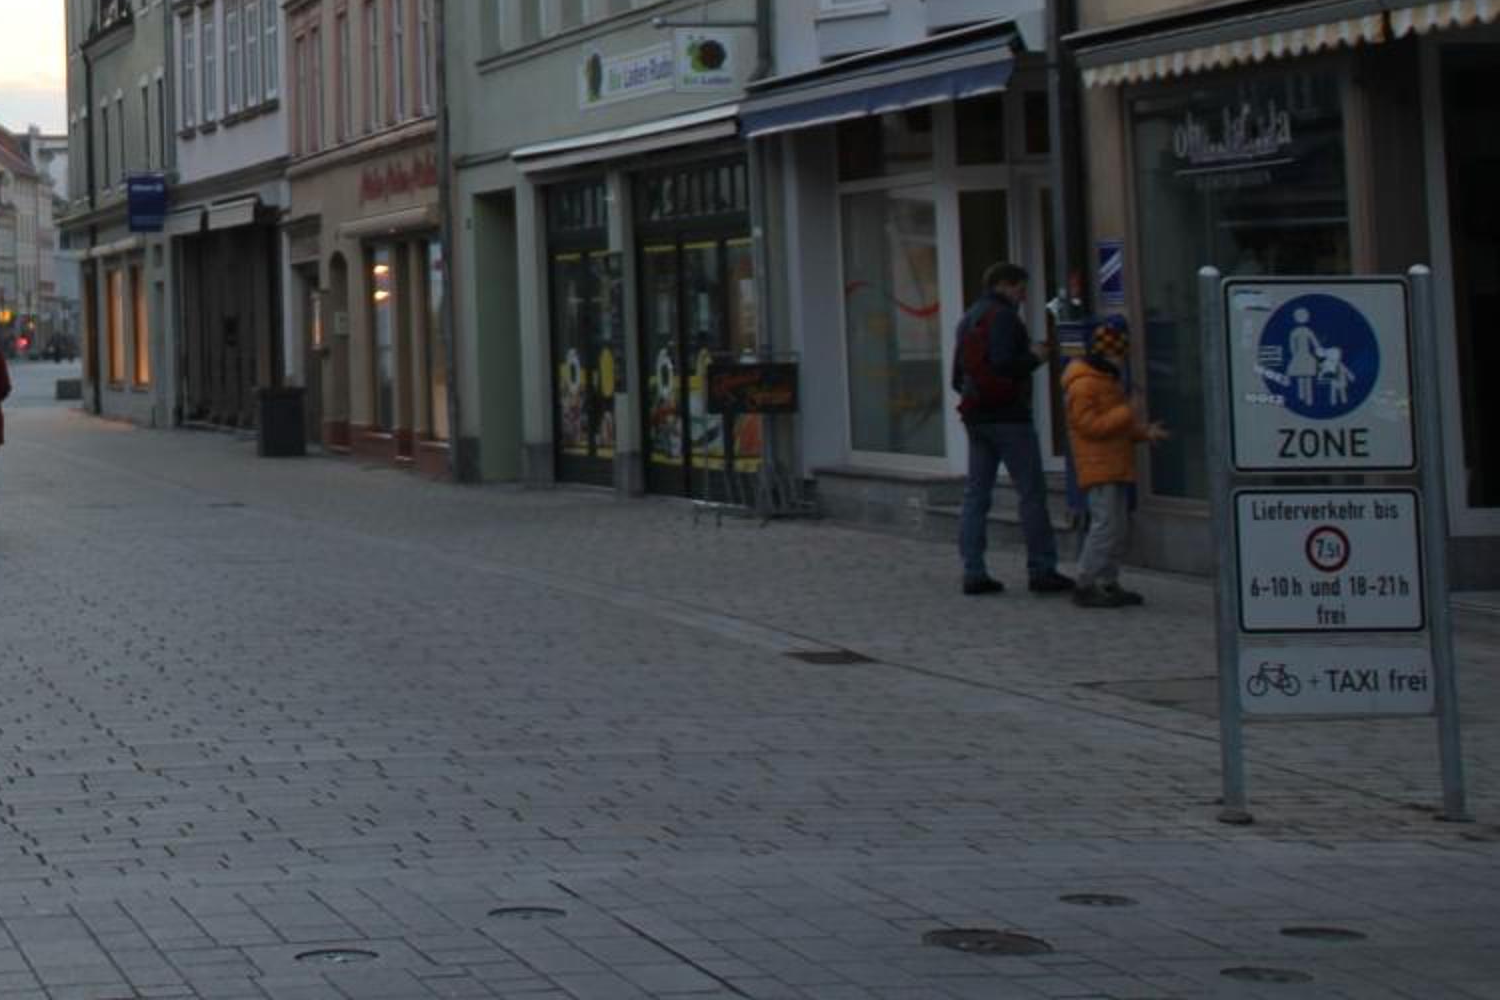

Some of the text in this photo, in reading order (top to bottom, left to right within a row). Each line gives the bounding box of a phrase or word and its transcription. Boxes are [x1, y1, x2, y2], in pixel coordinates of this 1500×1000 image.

[1279, 428, 1370, 458] ZONE
[1251, 498, 1399, 521] Lieferverkehr bis
[1310, 576, 1341, 597] und
[1317, 604, 1346, 625] frei
[1324, 669, 1380, 692] TAXI
[1389, 668, 1428, 692] frei
